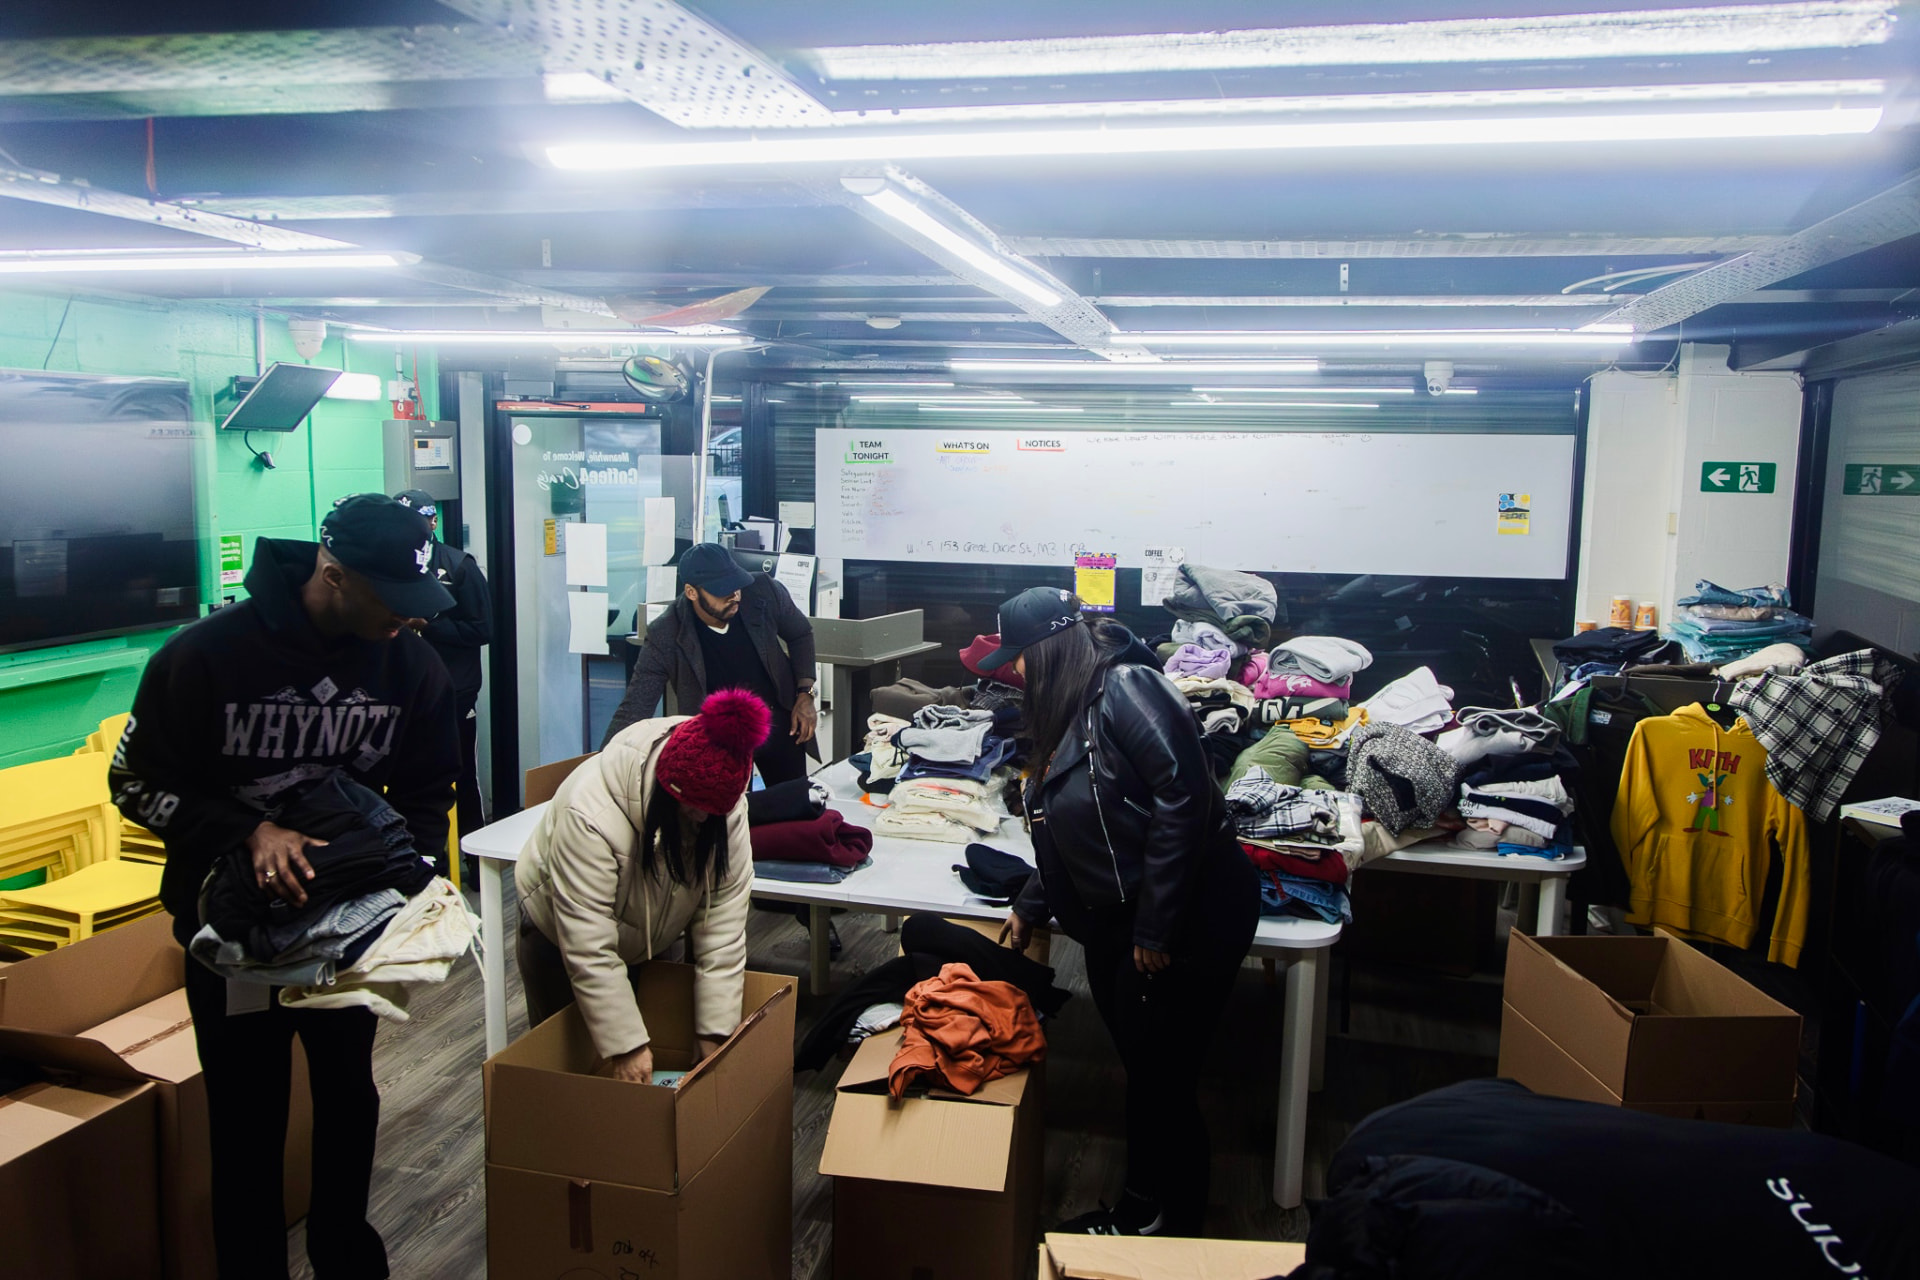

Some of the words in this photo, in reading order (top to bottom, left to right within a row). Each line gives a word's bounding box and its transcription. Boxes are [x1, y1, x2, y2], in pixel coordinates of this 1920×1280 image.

[943, 441, 975, 450] WHAT'S
[976, 442, 990, 450] ON
[1025, 440, 1061, 448] NOTICES
[852, 452, 889, 460] TONIGHT
[940, 540, 960, 553] 153
[1145, 549, 1163, 557] COFFEE
[1688, 748, 1741, 774] KITH
